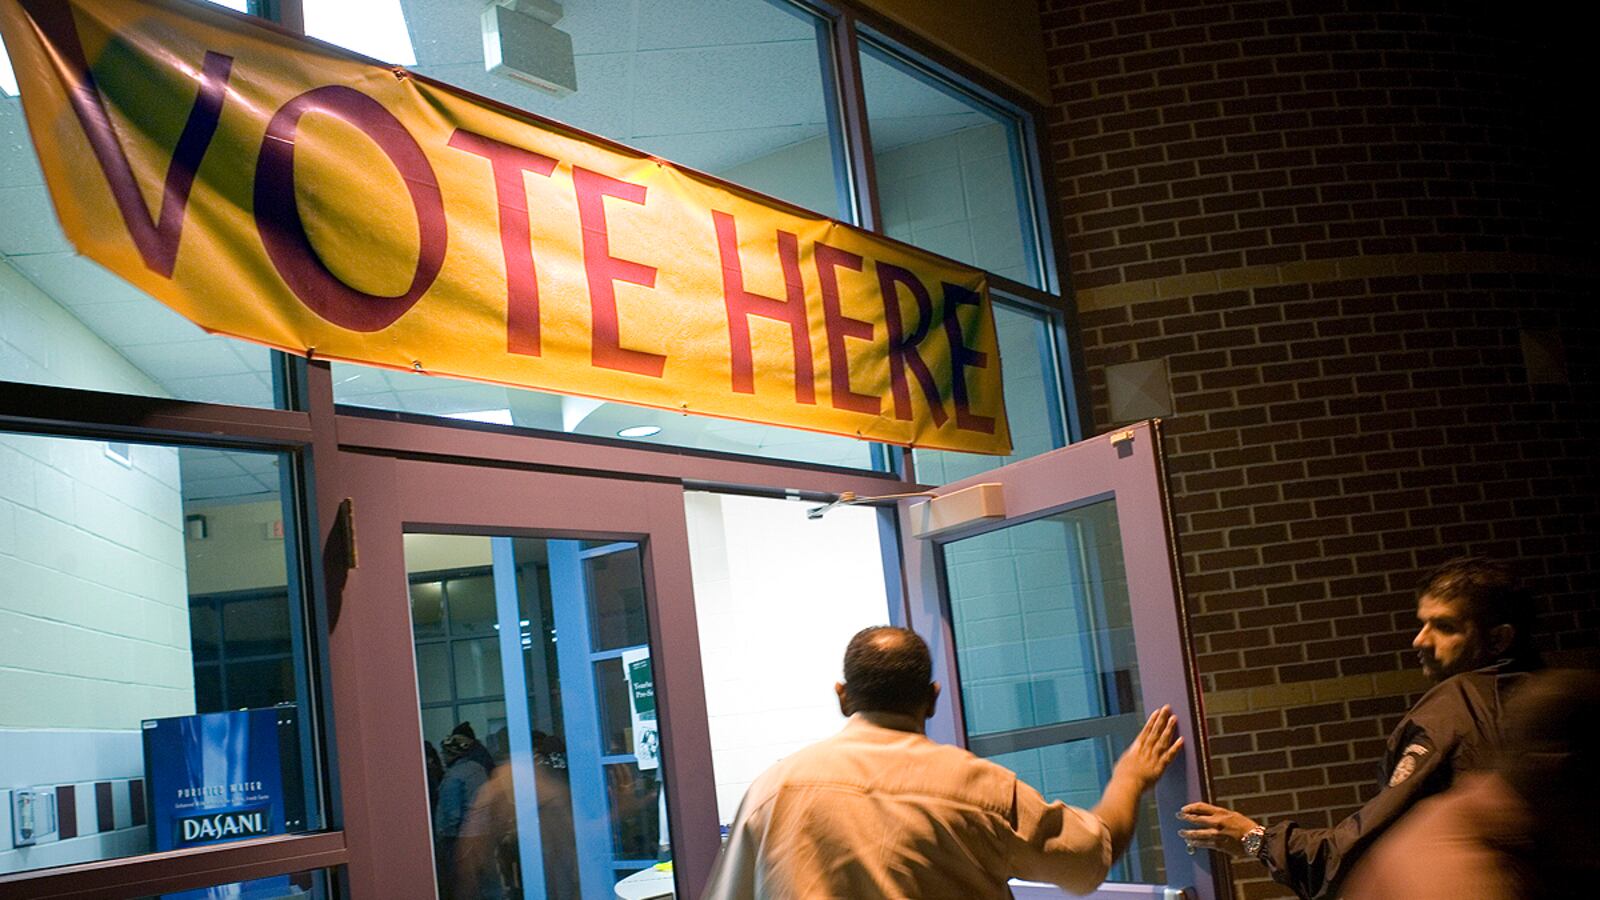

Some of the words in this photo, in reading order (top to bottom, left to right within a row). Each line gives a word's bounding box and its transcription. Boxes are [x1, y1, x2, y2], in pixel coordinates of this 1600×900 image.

[18, 0, 667, 377] VOTE
[712, 209, 995, 434] HERE
[177, 785, 225, 798] PURIFIED
[230, 781, 262, 793] WATER
[184, 813, 262, 840] DASANI
